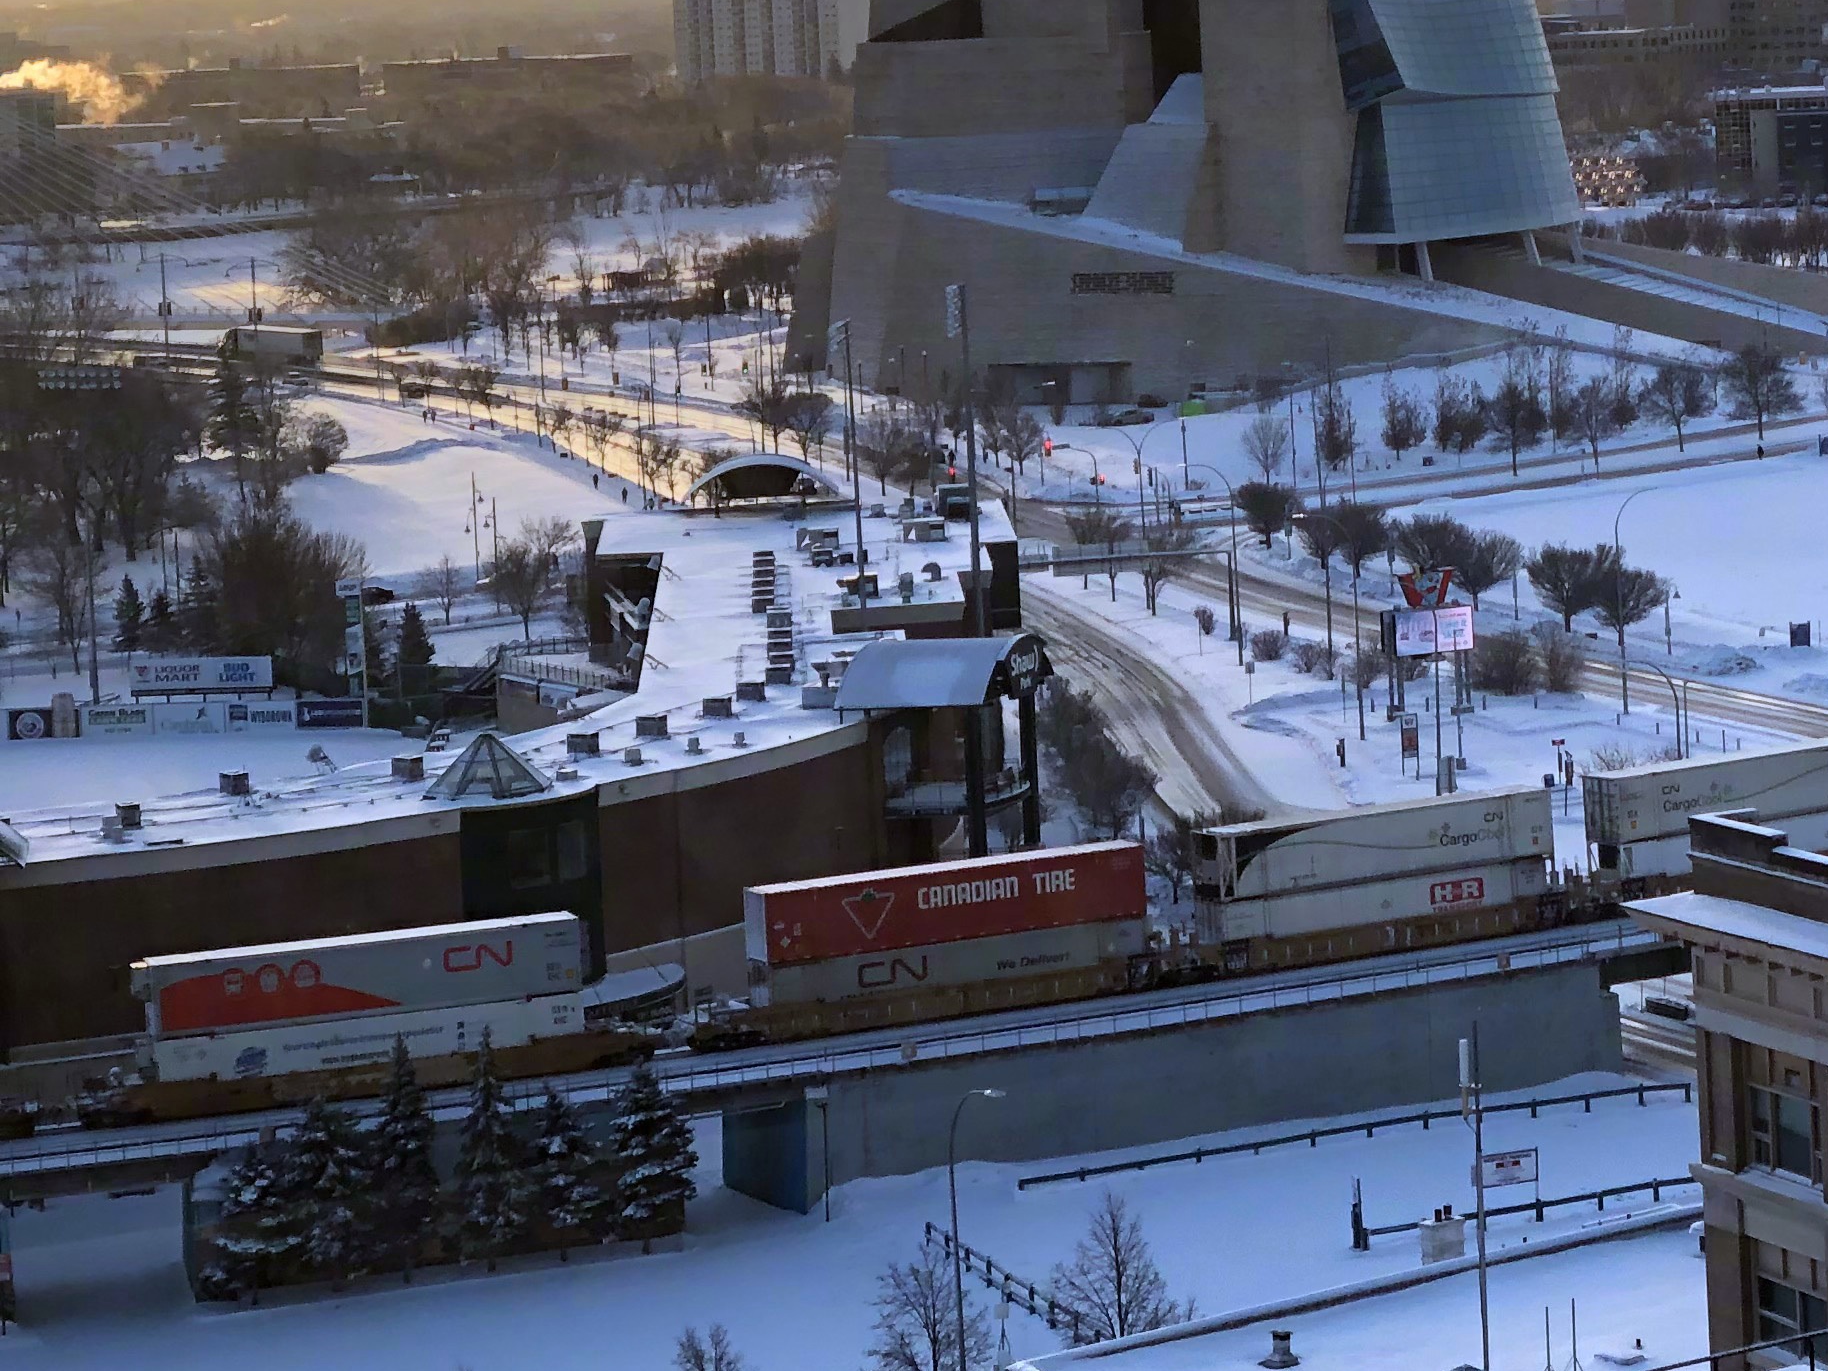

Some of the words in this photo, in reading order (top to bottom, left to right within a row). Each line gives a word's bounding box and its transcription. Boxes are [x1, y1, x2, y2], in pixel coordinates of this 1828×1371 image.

[154, 664, 200, 673] LIQUOR
[155, 673, 200, 682] MART
[219, 672, 256, 682] LIGHT
[1661, 784, 1680, 795] CN
[1483, 811, 1504, 823] CN
[917, 876, 1019, 910] CANADIAN
[1031, 868, 1076, 895] TIRE
[443, 939, 514, 972] CN
[996, 959, 1016, 971] We
[857, 955, 928, 988] CN
